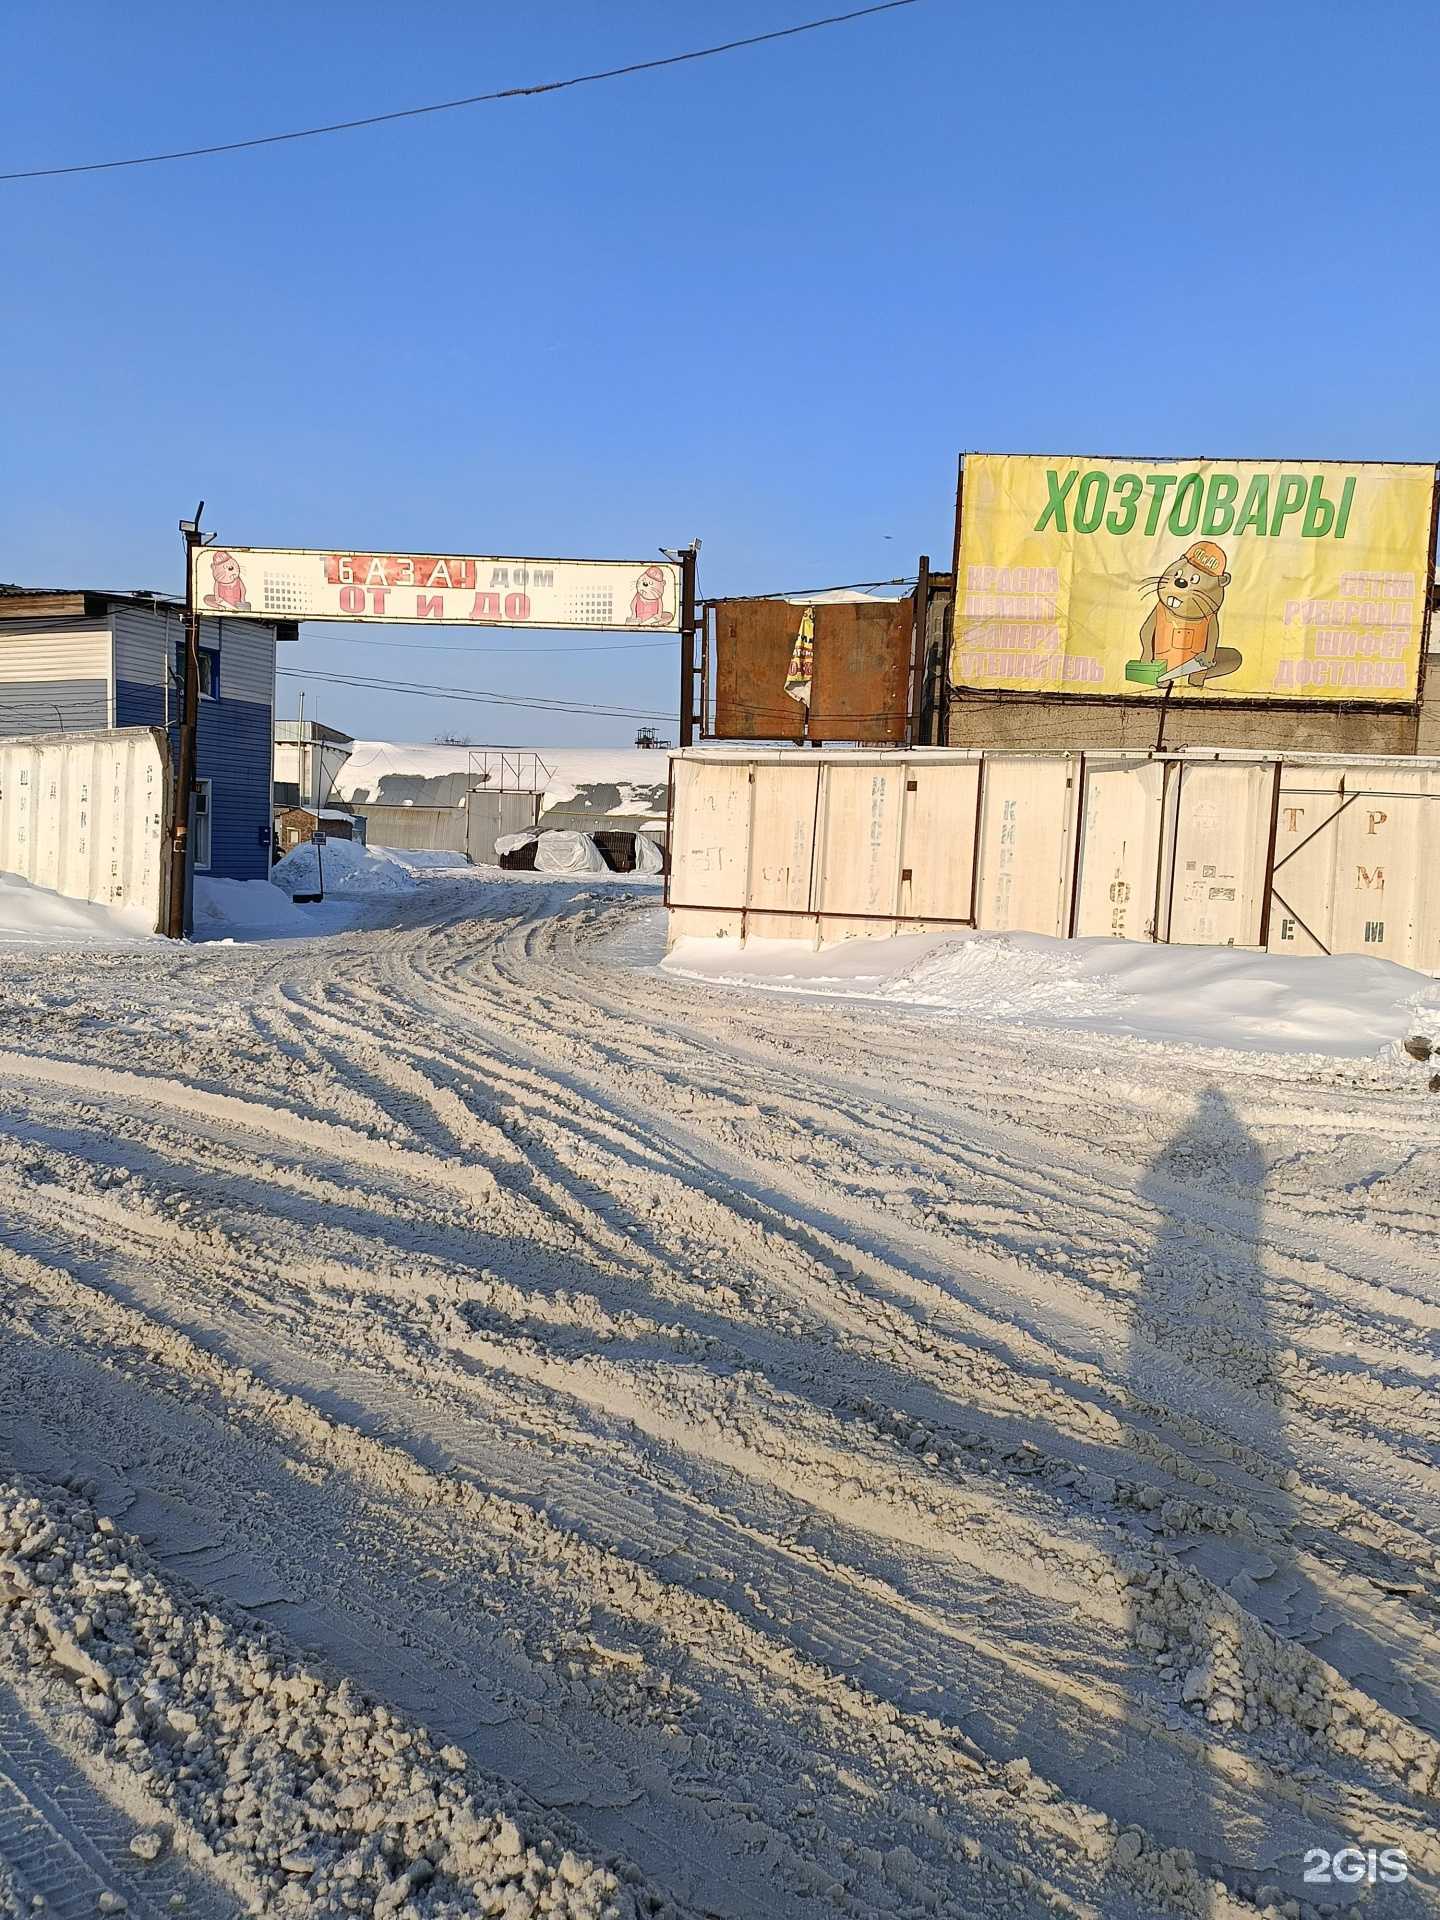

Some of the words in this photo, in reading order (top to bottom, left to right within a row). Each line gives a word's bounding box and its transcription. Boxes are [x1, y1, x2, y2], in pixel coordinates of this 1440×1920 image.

[1034, 470, 1357, 539] ХОЗТОВАРЫ
[968, 566, 1059, 593] КРАСКА
[1339, 571, 1415, 599] СЕТКА
[339, 586, 391, 614] ОТ
[469, 592, 531, 620] ДО
[1284, 600, 1412, 633] РУБЕРОИД
[1315, 631, 1409, 658] ШИФЕР
[960, 652, 1105, 682] УТЕПЛИТЕЛЬ
[1273, 659, 1408, 689] ДОСТАВКА
